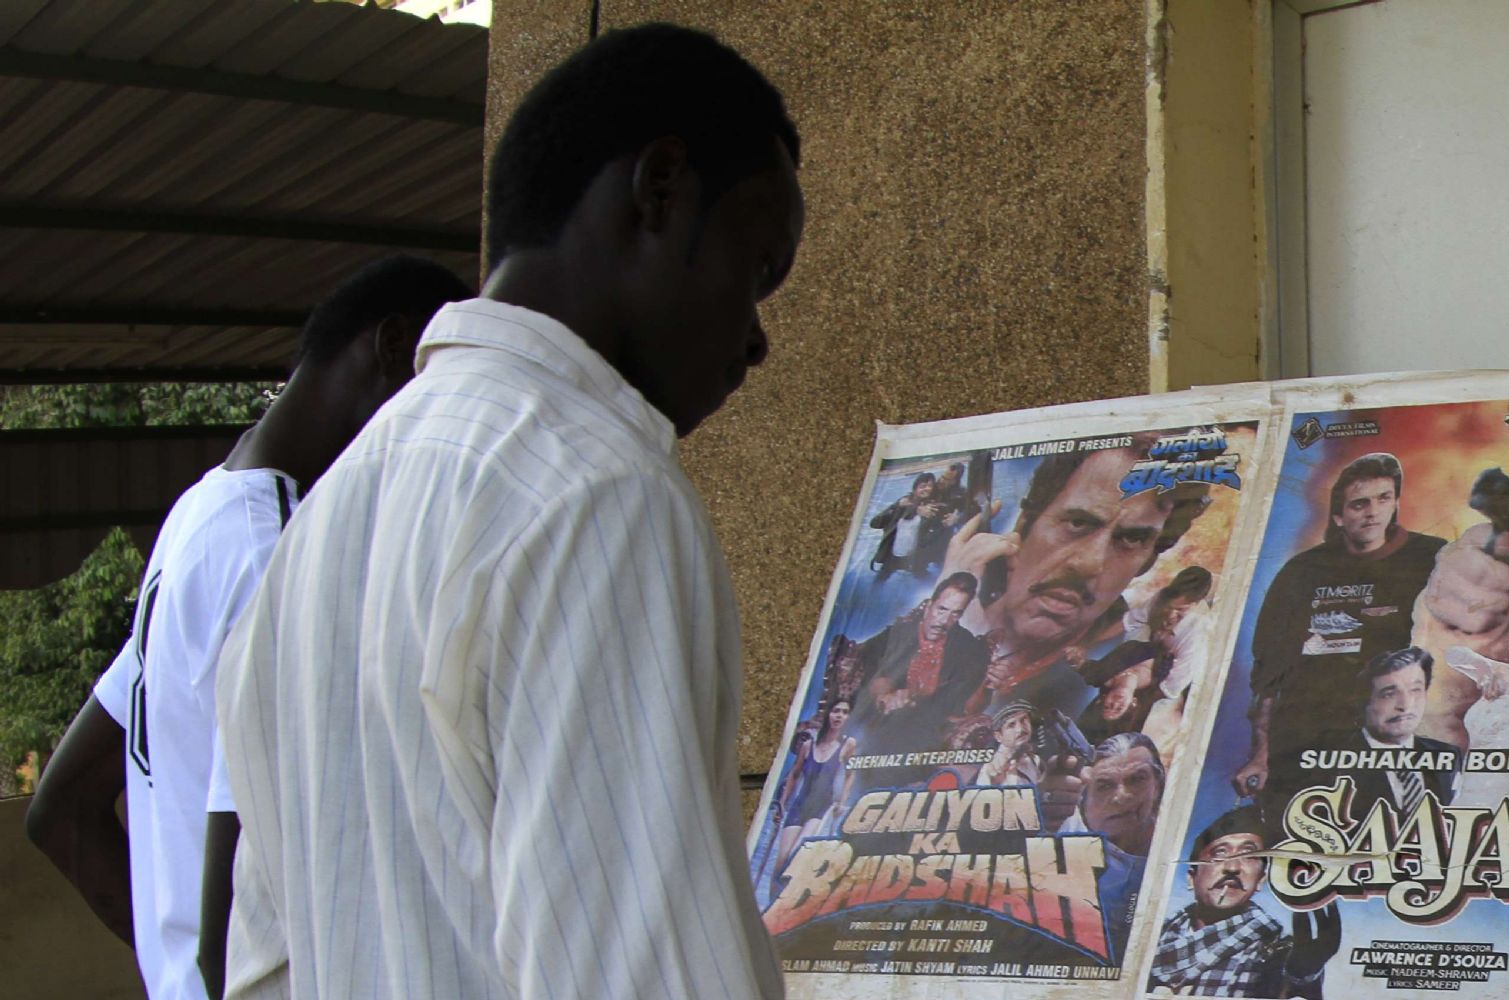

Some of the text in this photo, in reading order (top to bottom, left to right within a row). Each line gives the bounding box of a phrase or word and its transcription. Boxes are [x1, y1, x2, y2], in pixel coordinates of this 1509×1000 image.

[991, 436, 1133, 461] JALIL AHMED PRESENTS
[846, 749, 995, 770] SHEHNAZ ENTERPRISES
[1299, 750, 1455, 771] SUDHAKAR
[841, 787, 1041, 834] GALIYON
[908, 832, 962, 855] KA
[762, 836, 1109, 961] BADSHAH
[894, 921, 907, 931] BY
[909, 919, 944, 931] RAFIK
[945, 920, 988, 932] AHMED
[833, 938, 994, 953] DIRECTED BY KANTI SHAH
[1371, 941, 1444, 951] CINEMATOGRAPHER
[1453, 943, 1493, 952] DIRECTOR
[1352, 950, 1506, 970] LAWRENCE D'SOUZA
[851, 963, 878, 973] MUSIC
[880, 961, 912, 973] JATIN
[914, 961, 956, 974] SHYAM
[957, 964, 988, 975] LYRICS
[990, 963, 1022, 976] JALIL
[1025, 964, 1069, 978] AHMED
[1073, 967, 1121, 980] UNNAVI
[1366, 967, 1489, 980] MUSIC NADEEM-SHRAVAN
[1388, 979, 1461, 990] LYRICS SAMEER
